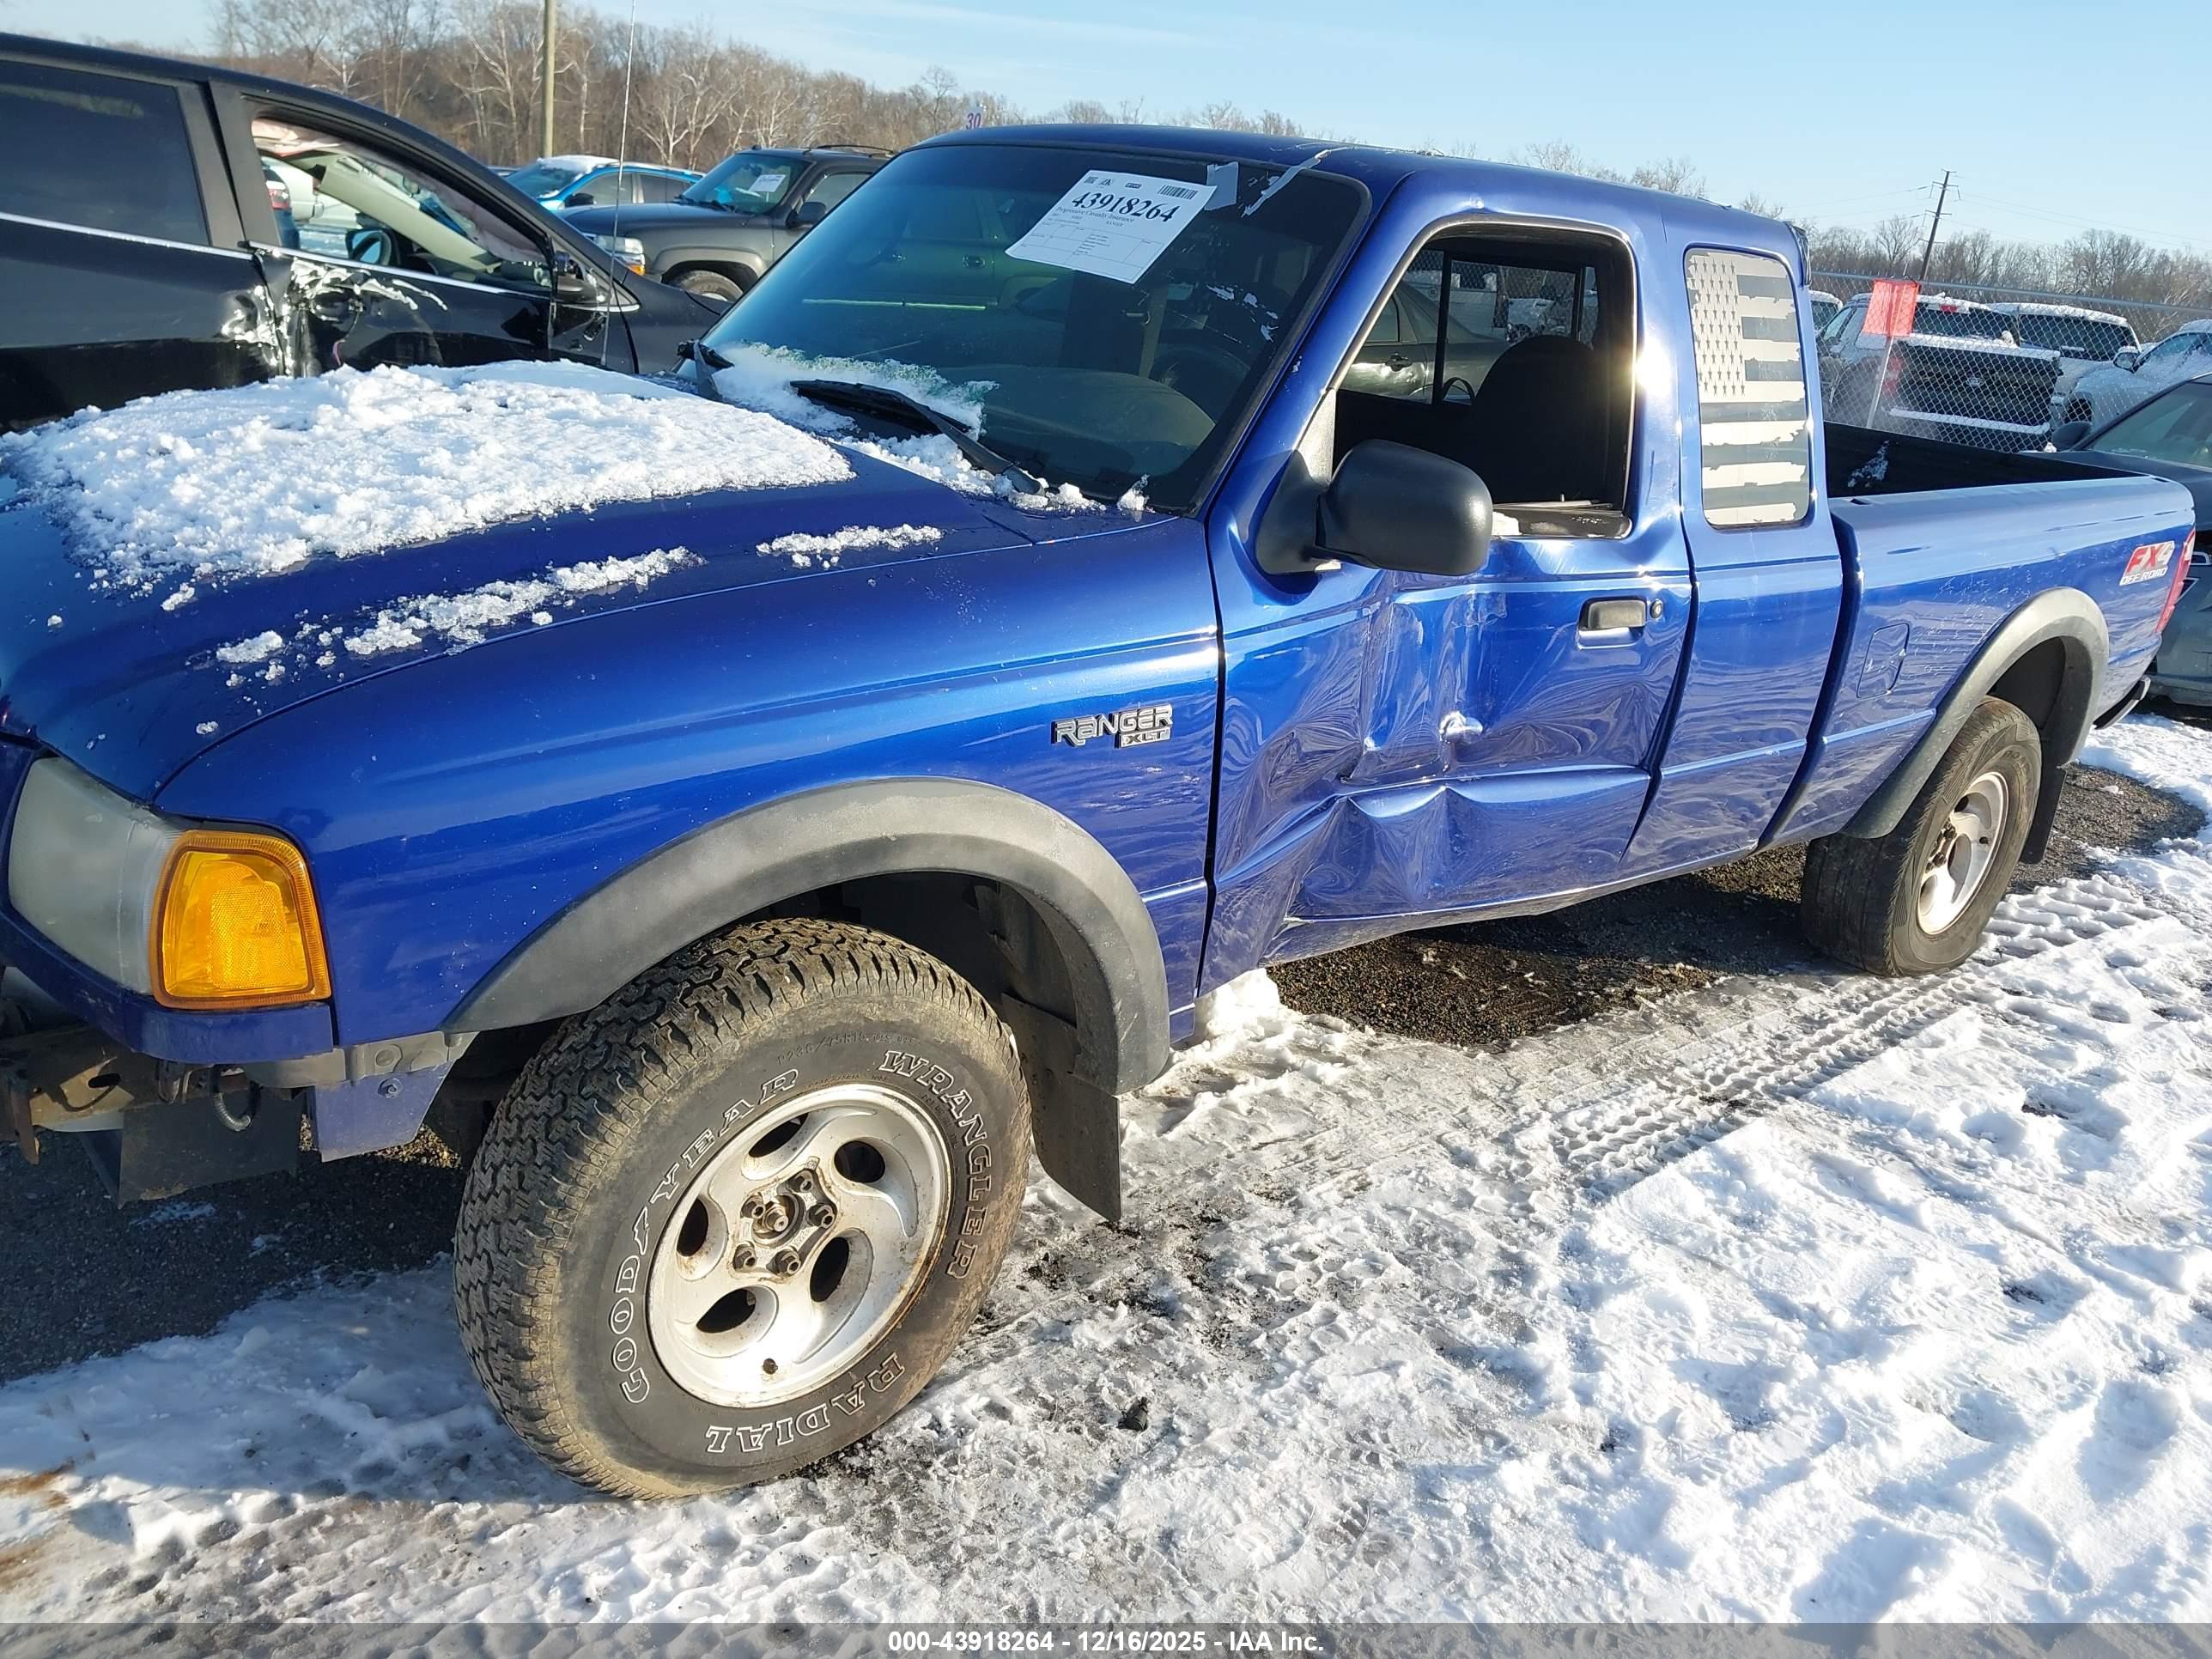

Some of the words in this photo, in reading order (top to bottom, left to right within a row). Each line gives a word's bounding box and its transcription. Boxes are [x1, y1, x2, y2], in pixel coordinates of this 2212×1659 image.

[965, 112, 981, 130] 30
[1056, 206, 1085, 216] Progressive
[1072, 191, 1180, 222] 43918264
[2127, 541, 2174, 573] FX4
[2122, 574, 2141, 585] OFF
[2142, 568, 2168, 580] ROAD
[1051, 703, 1173, 746] RANGER
[1124, 730, 1167, 744] XLT
[879, 1049, 994, 1279] WRANGLER
[608, 1067, 799, 1404] GOODYEAR
[705, 1352, 906, 1455] RADIAL
